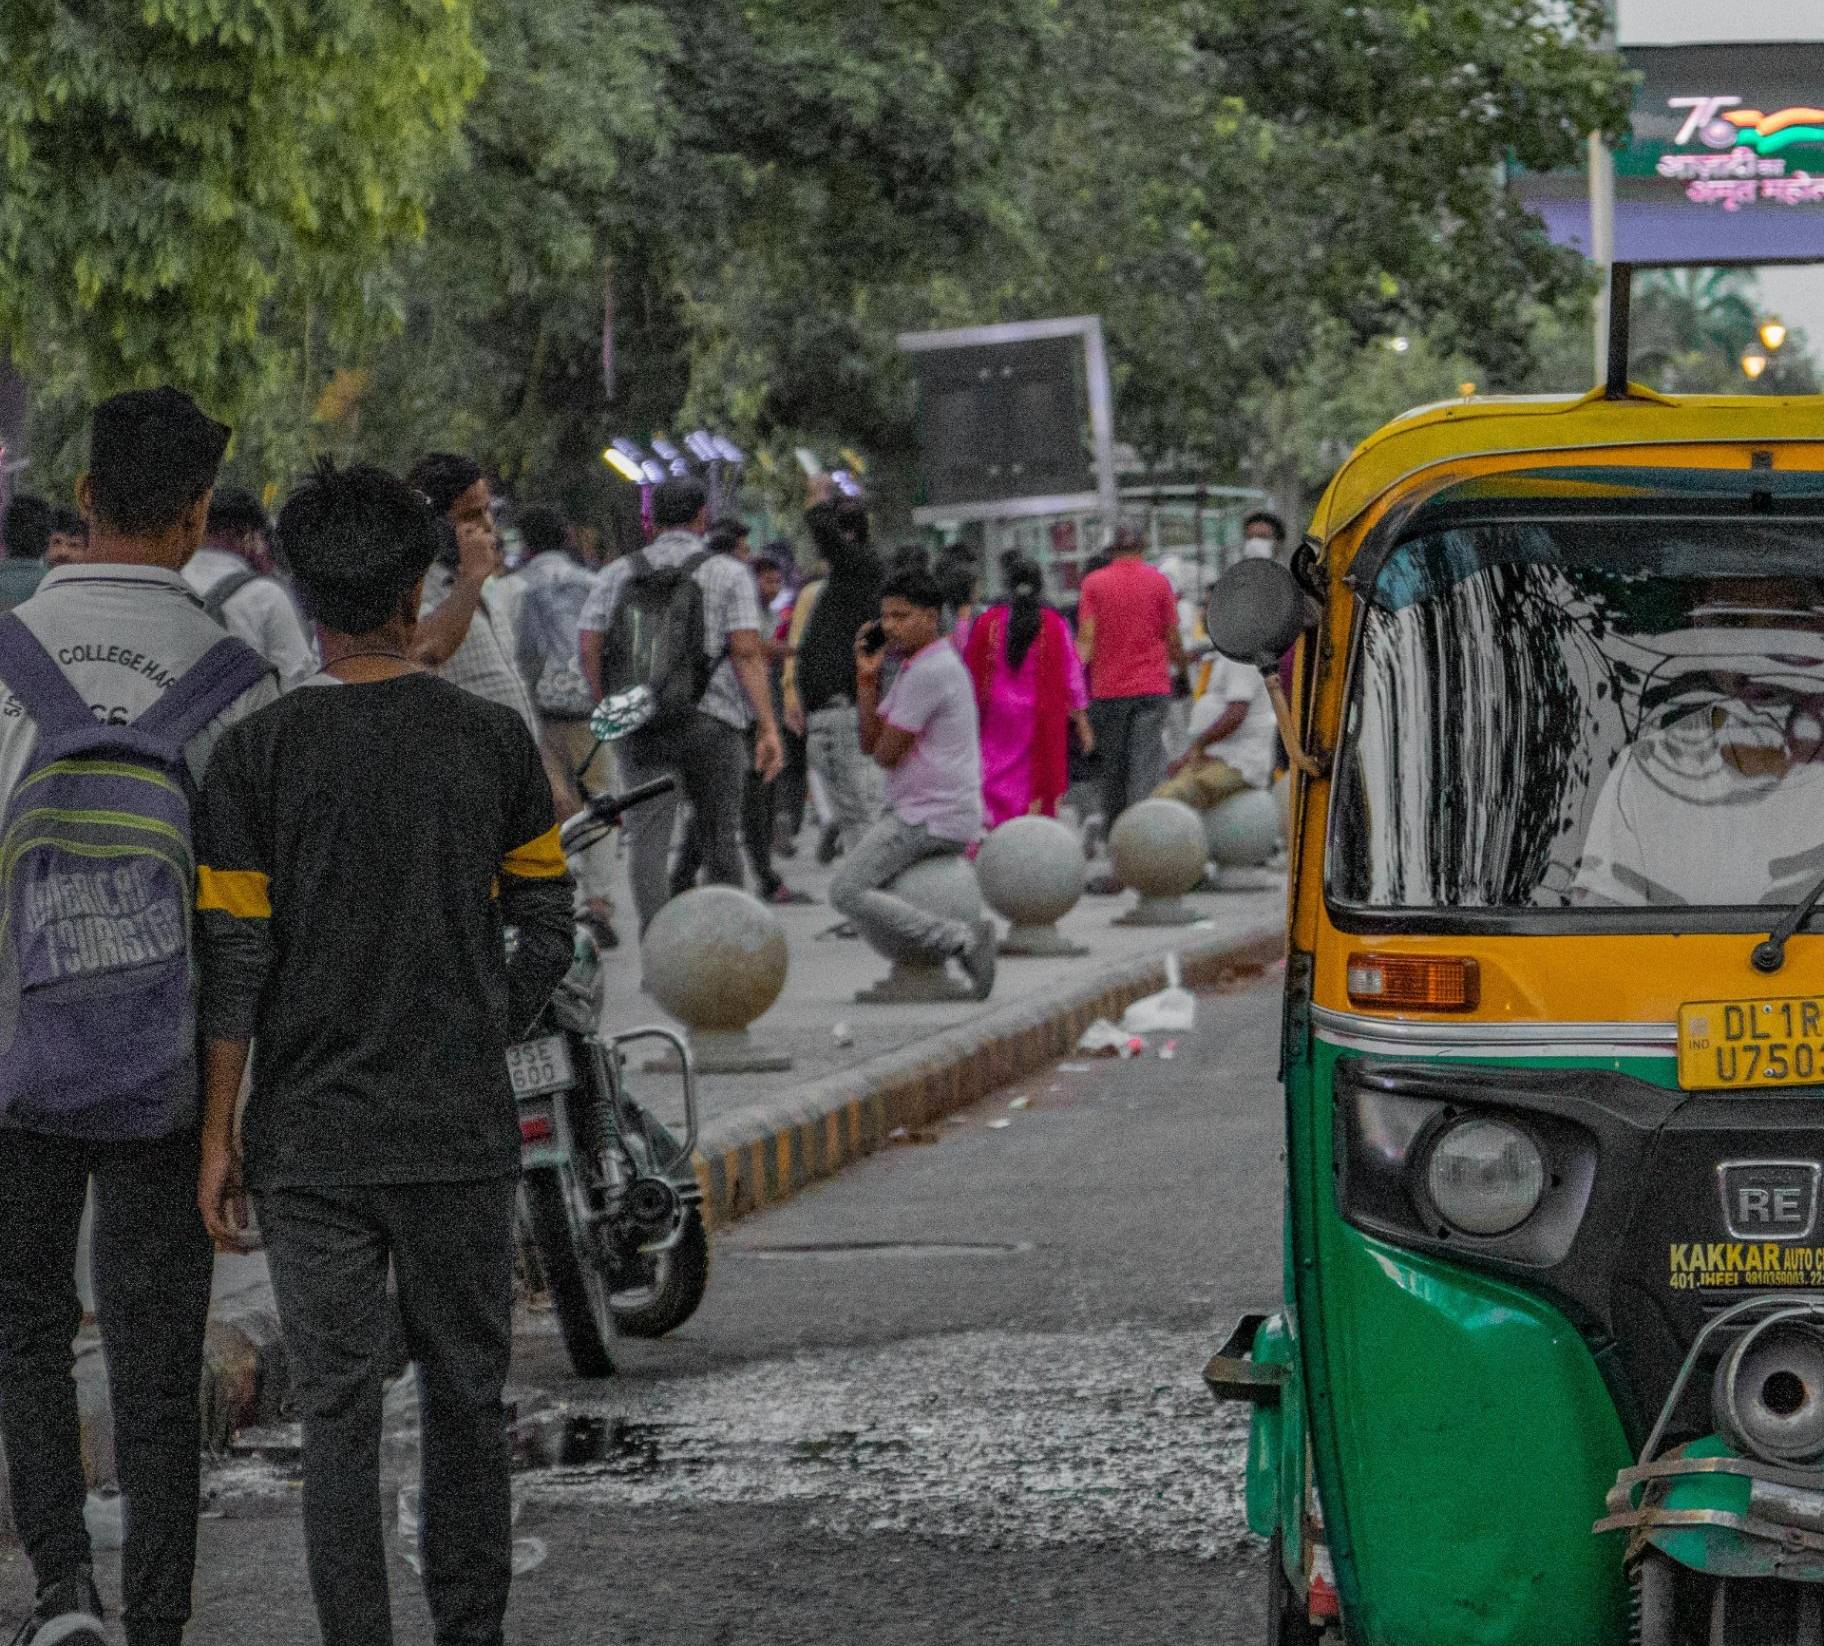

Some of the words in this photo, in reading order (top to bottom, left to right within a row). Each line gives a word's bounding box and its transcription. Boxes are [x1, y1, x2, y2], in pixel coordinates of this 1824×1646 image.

[58, 644, 145, 671] COLLEGE
[1689, 1040, 1709, 1050] IND
[1739, 1188, 1801, 1222] RE
[1670, 1243, 1781, 1271] KAKKAR
[1784, 1247, 1811, 1271] AUTO
